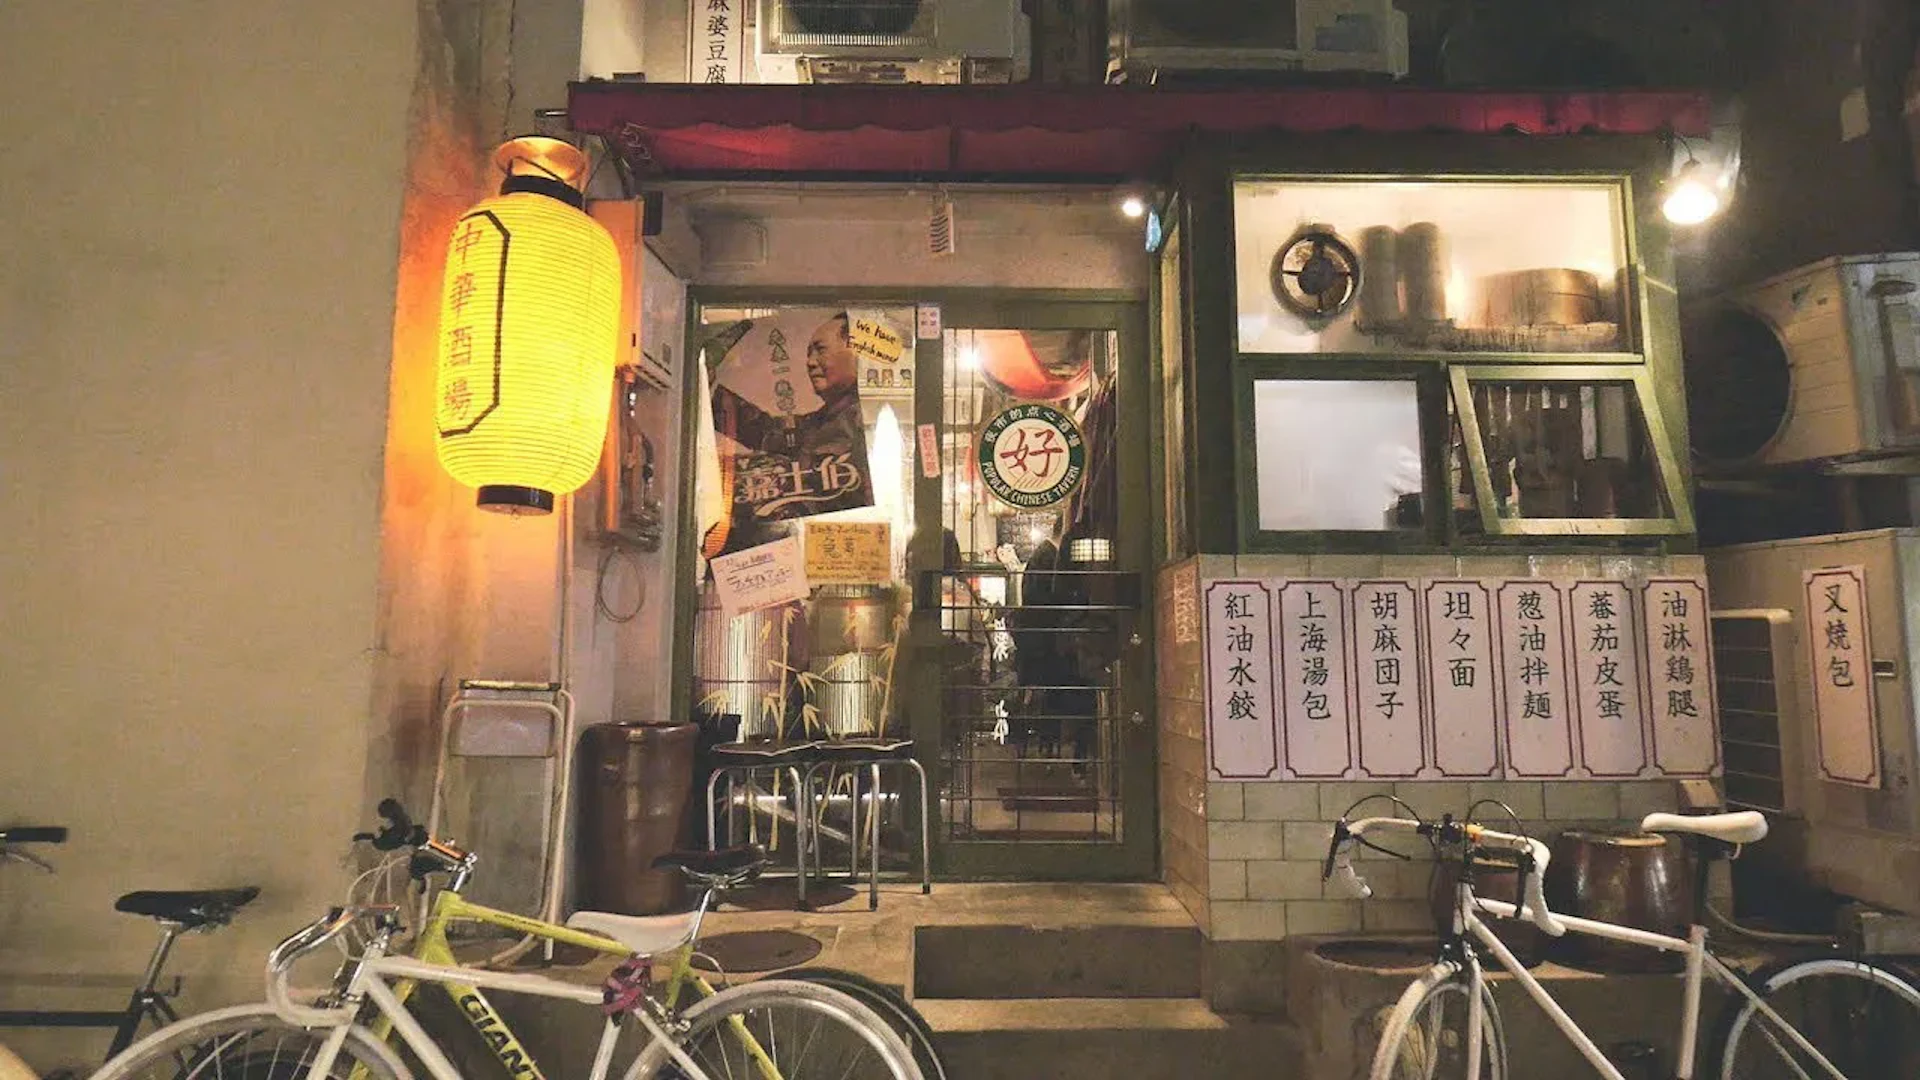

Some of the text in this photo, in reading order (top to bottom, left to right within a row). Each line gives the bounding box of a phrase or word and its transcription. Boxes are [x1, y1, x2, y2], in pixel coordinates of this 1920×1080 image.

[856, 319, 896, 345] We have
[982, 462, 1080, 505] POPULAR CHINESE TAVERN
[1000, 428, 1064, 478] 好
[1224, 592, 1258, 721] 紅油水餃
[1298, 591, 1332, 720] 上海湯包
[1371, 591, 1404, 720] 胡麻団子
[459, 994, 537, 1080] GIAN
